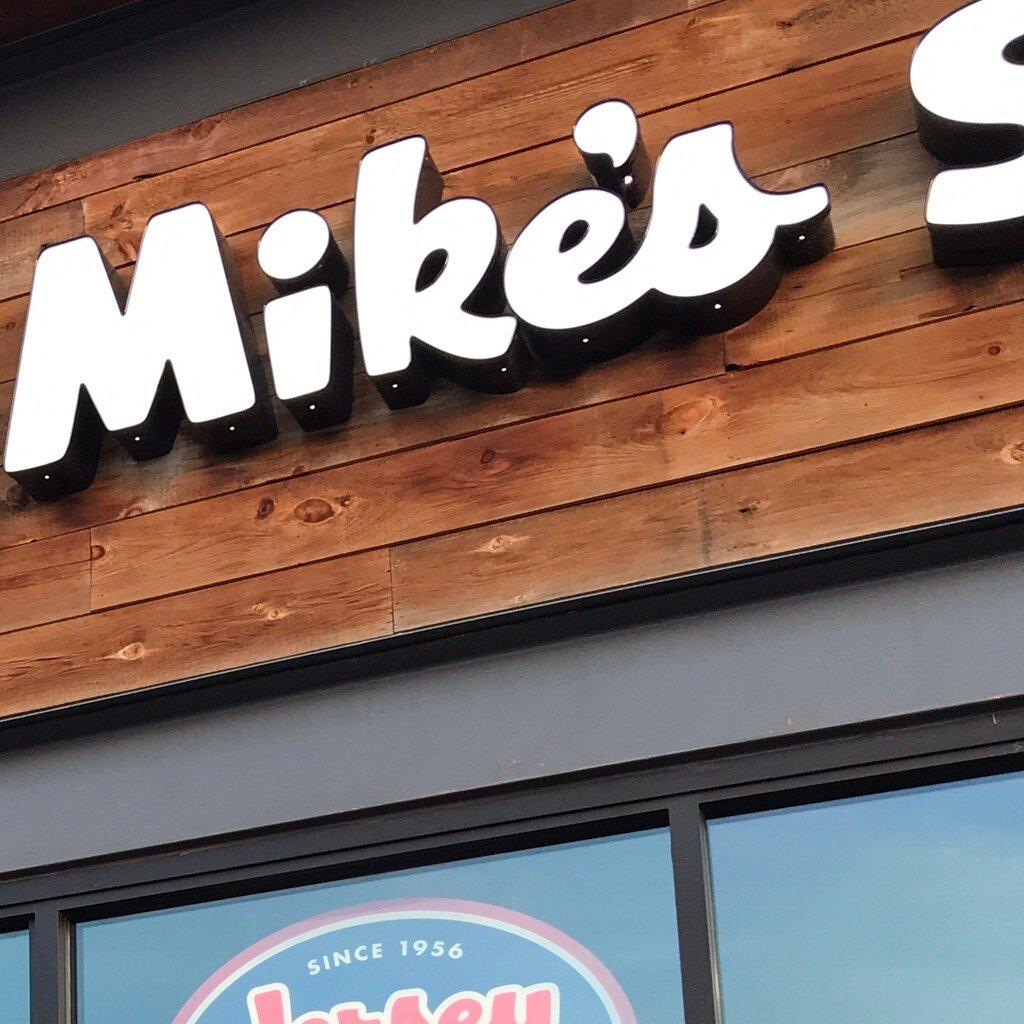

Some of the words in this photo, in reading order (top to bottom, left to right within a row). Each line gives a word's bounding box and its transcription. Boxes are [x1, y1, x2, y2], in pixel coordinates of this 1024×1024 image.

[5, 102, 830, 474] Mike's
[307, 942, 384, 976] SINCE
[399, 940, 464, 960] 1956
